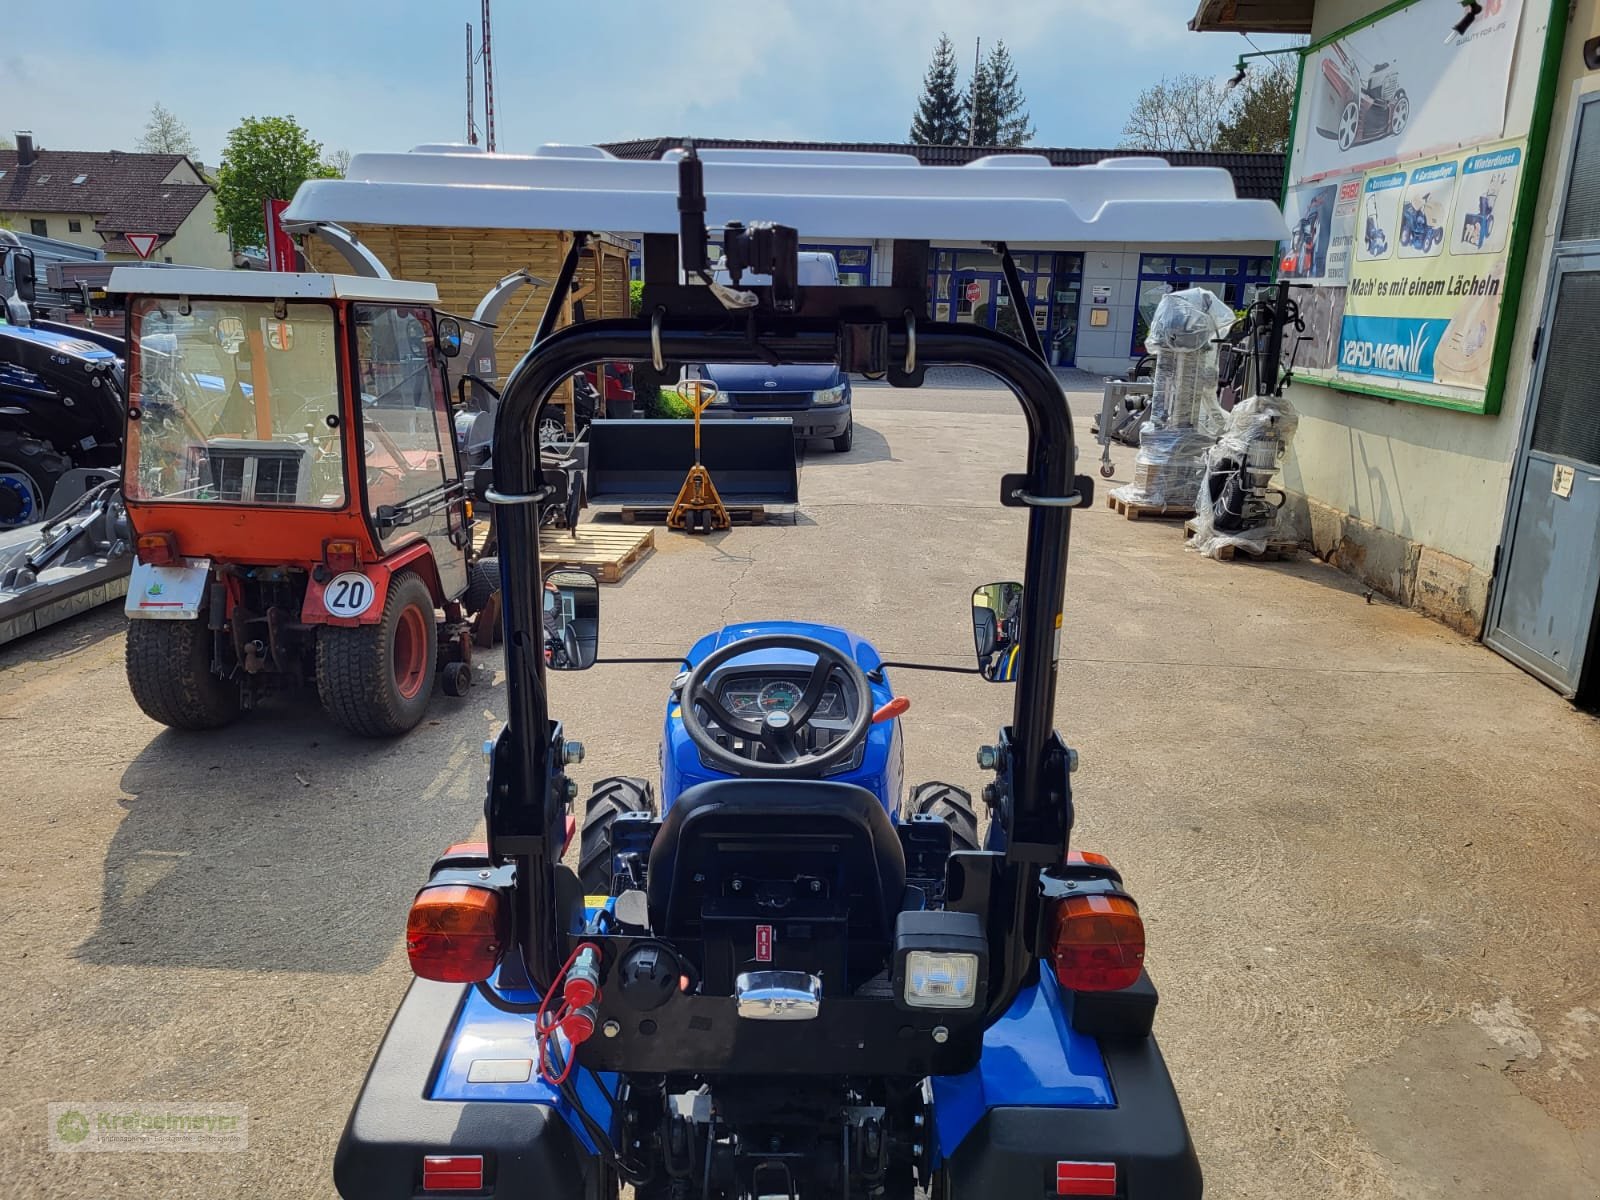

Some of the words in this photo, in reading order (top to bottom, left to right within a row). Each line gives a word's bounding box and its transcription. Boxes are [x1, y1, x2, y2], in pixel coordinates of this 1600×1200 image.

[1474, 152, 1515, 170] Winterdienst
[1350, 278, 1377, 296] Mach'
[1377, 283, 1387, 296] es
[1389, 277, 1409, 296] mit
[1408, 276, 1446, 296] einem
[1446, 274, 1500, 296] Lächeln
[332, 580, 365, 609] 20
